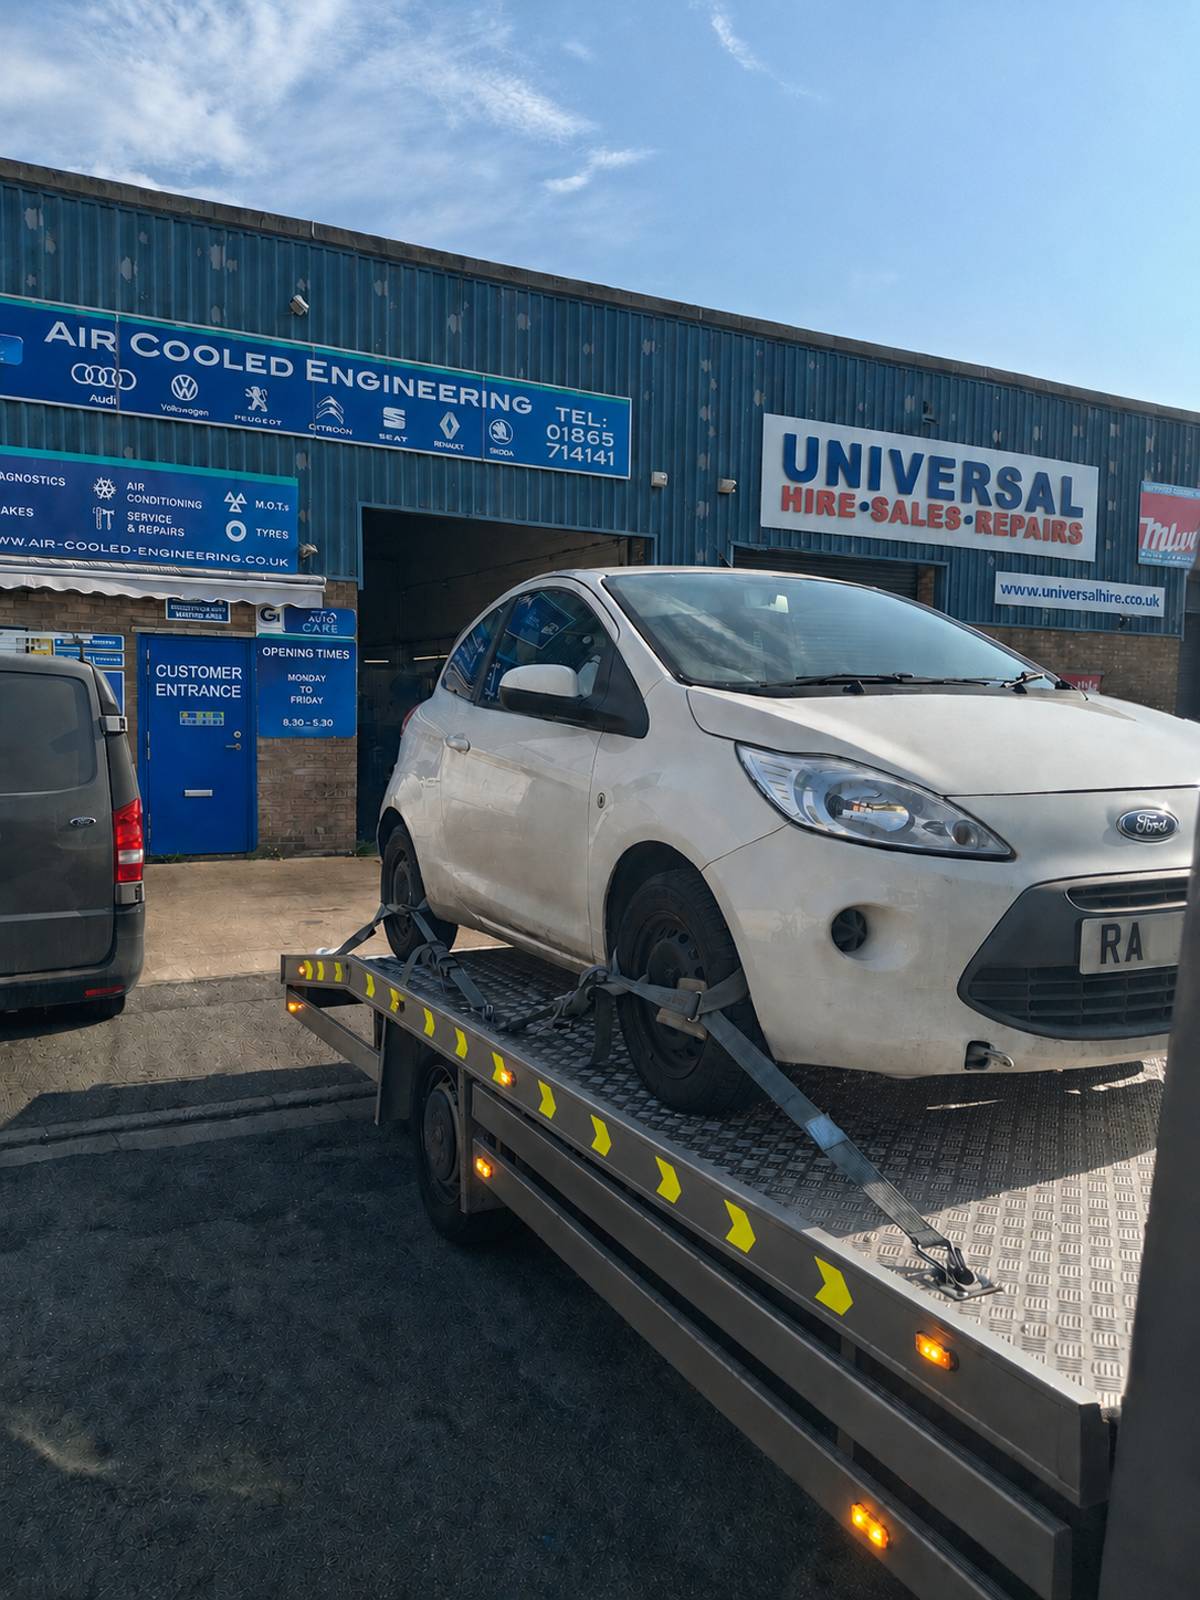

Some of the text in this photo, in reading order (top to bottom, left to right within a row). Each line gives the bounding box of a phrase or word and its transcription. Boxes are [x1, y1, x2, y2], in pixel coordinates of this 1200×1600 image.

[44, 321, 533, 415] AIR COOLED ENGINEERING
[89, 394, 117, 405] Audi
[234, 414, 282, 426] PEUGEOT
[555, 406, 609, 428] TEL:
[379, 433, 408, 442] SEAT
[546, 425, 615, 447] 01865
[546, 443, 615, 466] 714141
[782, 432, 1084, 519] UNIVERSAL
[126, 482, 145, 492] AIR
[126, 494, 203, 510] CONDITIONING
[127, 511, 172, 525] SERVICE
[127, 524, 185, 538] & REPAIRS
[255, 527, 289, 540] TYRES
[302, 622, 338, 634] CARE
[262, 646, 350, 660] OPENING TIMES
[155, 664, 243, 681] CUSTOMER
[287, 673, 327, 683] MONDAY
[155, 683, 242, 699] ENTRANCE
[300, 685, 313, 694] TO
[290, 695, 324, 705] FRIDAY
[282, 718, 305, 728] 8.30
[1136, 814, 1168, 834] Ford
[1100, 921, 1144, 965] RA
